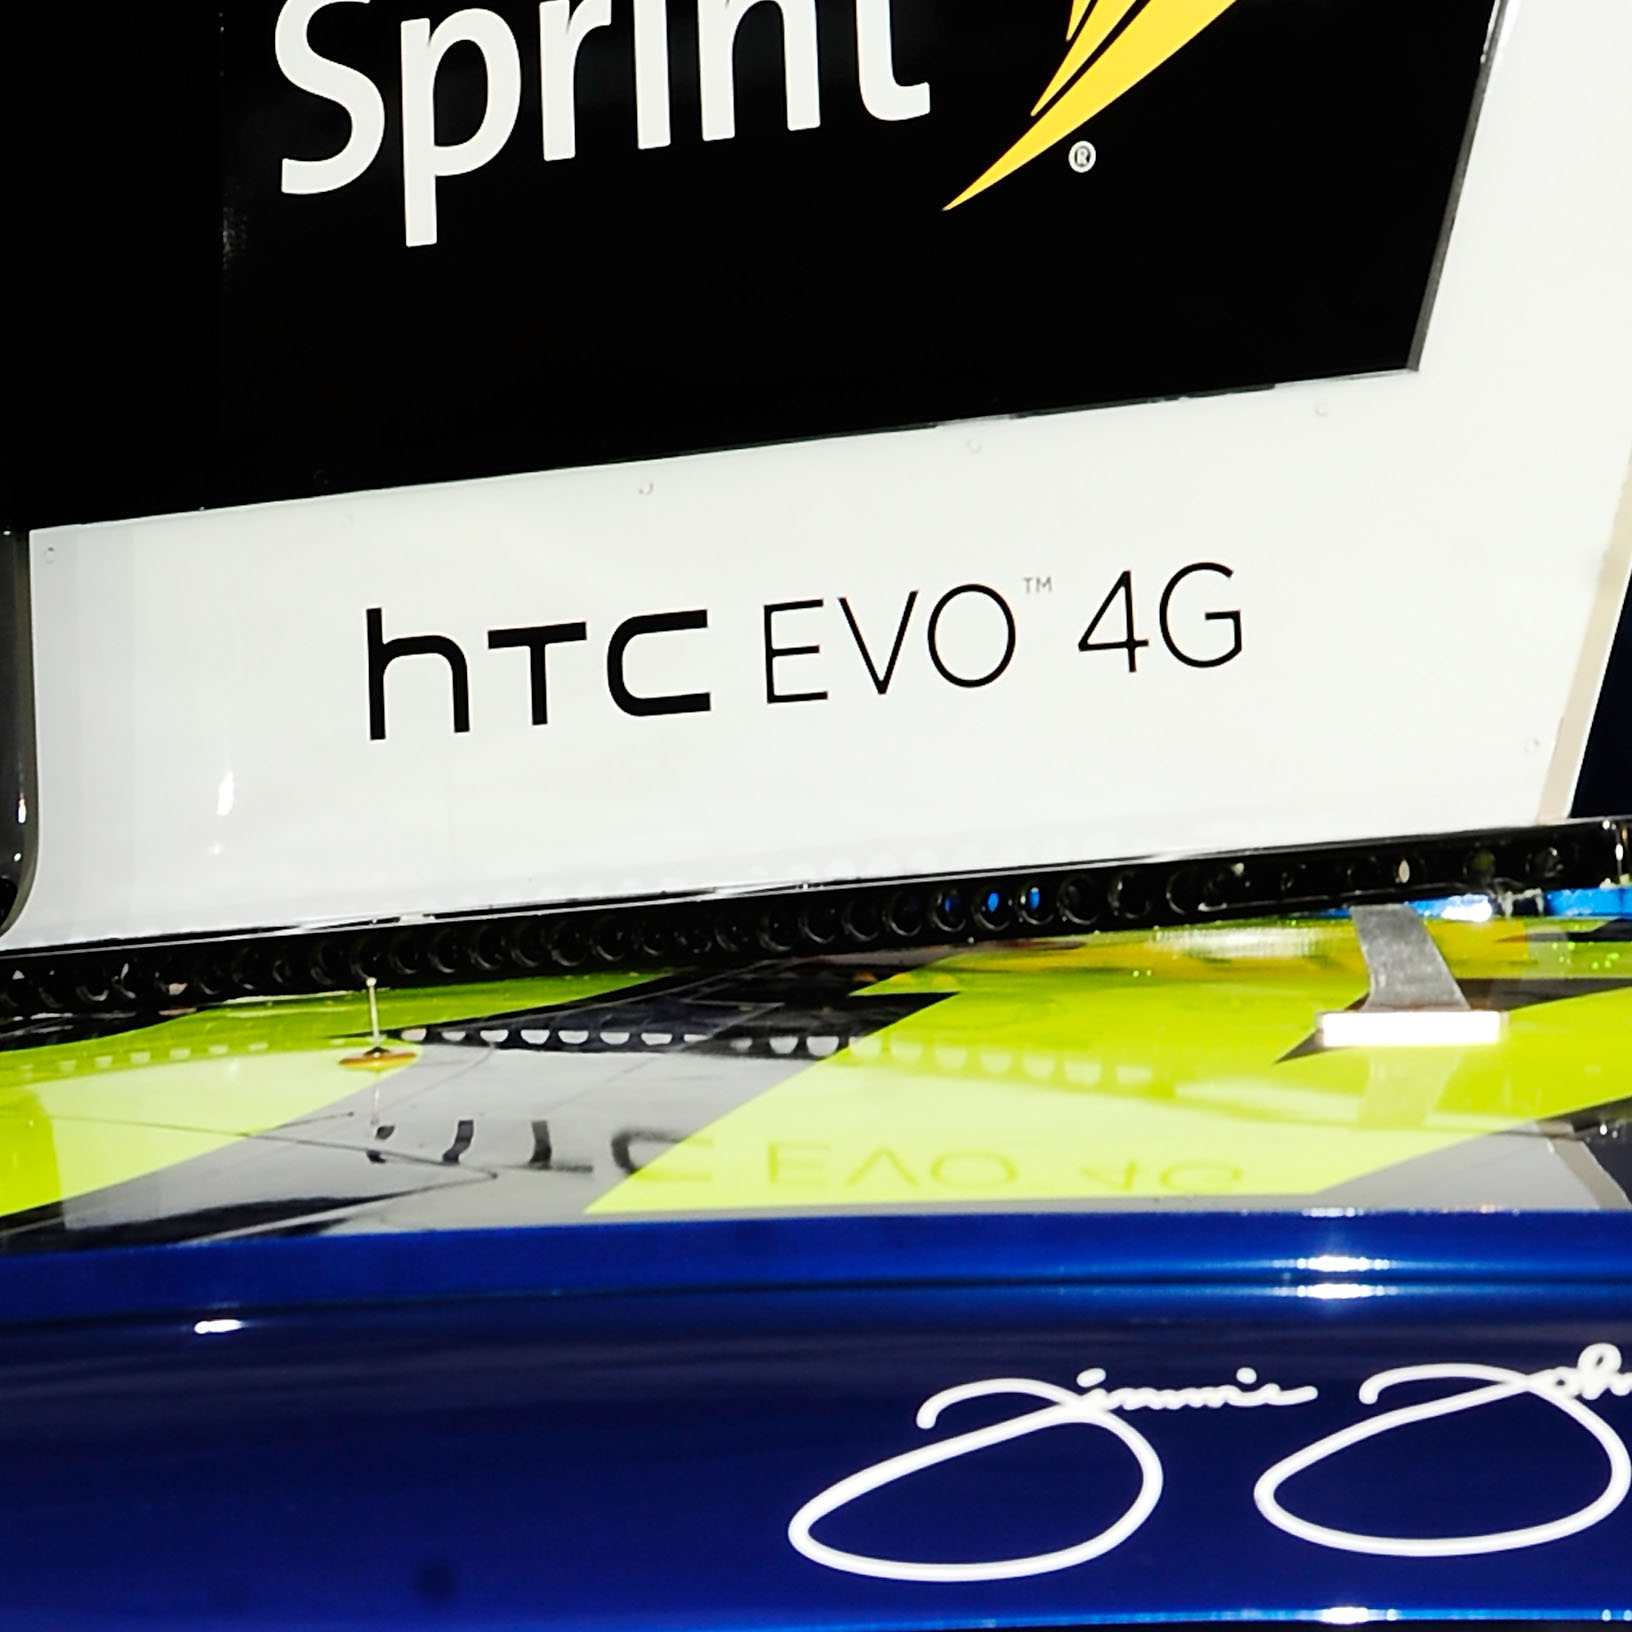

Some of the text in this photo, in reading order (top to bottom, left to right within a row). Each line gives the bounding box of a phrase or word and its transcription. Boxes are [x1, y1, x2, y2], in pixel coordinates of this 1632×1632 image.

[762, 582, 1018, 706] EVO
[1076, 560, 1245, 674] 4G
[788, 1365, 1320, 1582] Jimmie
